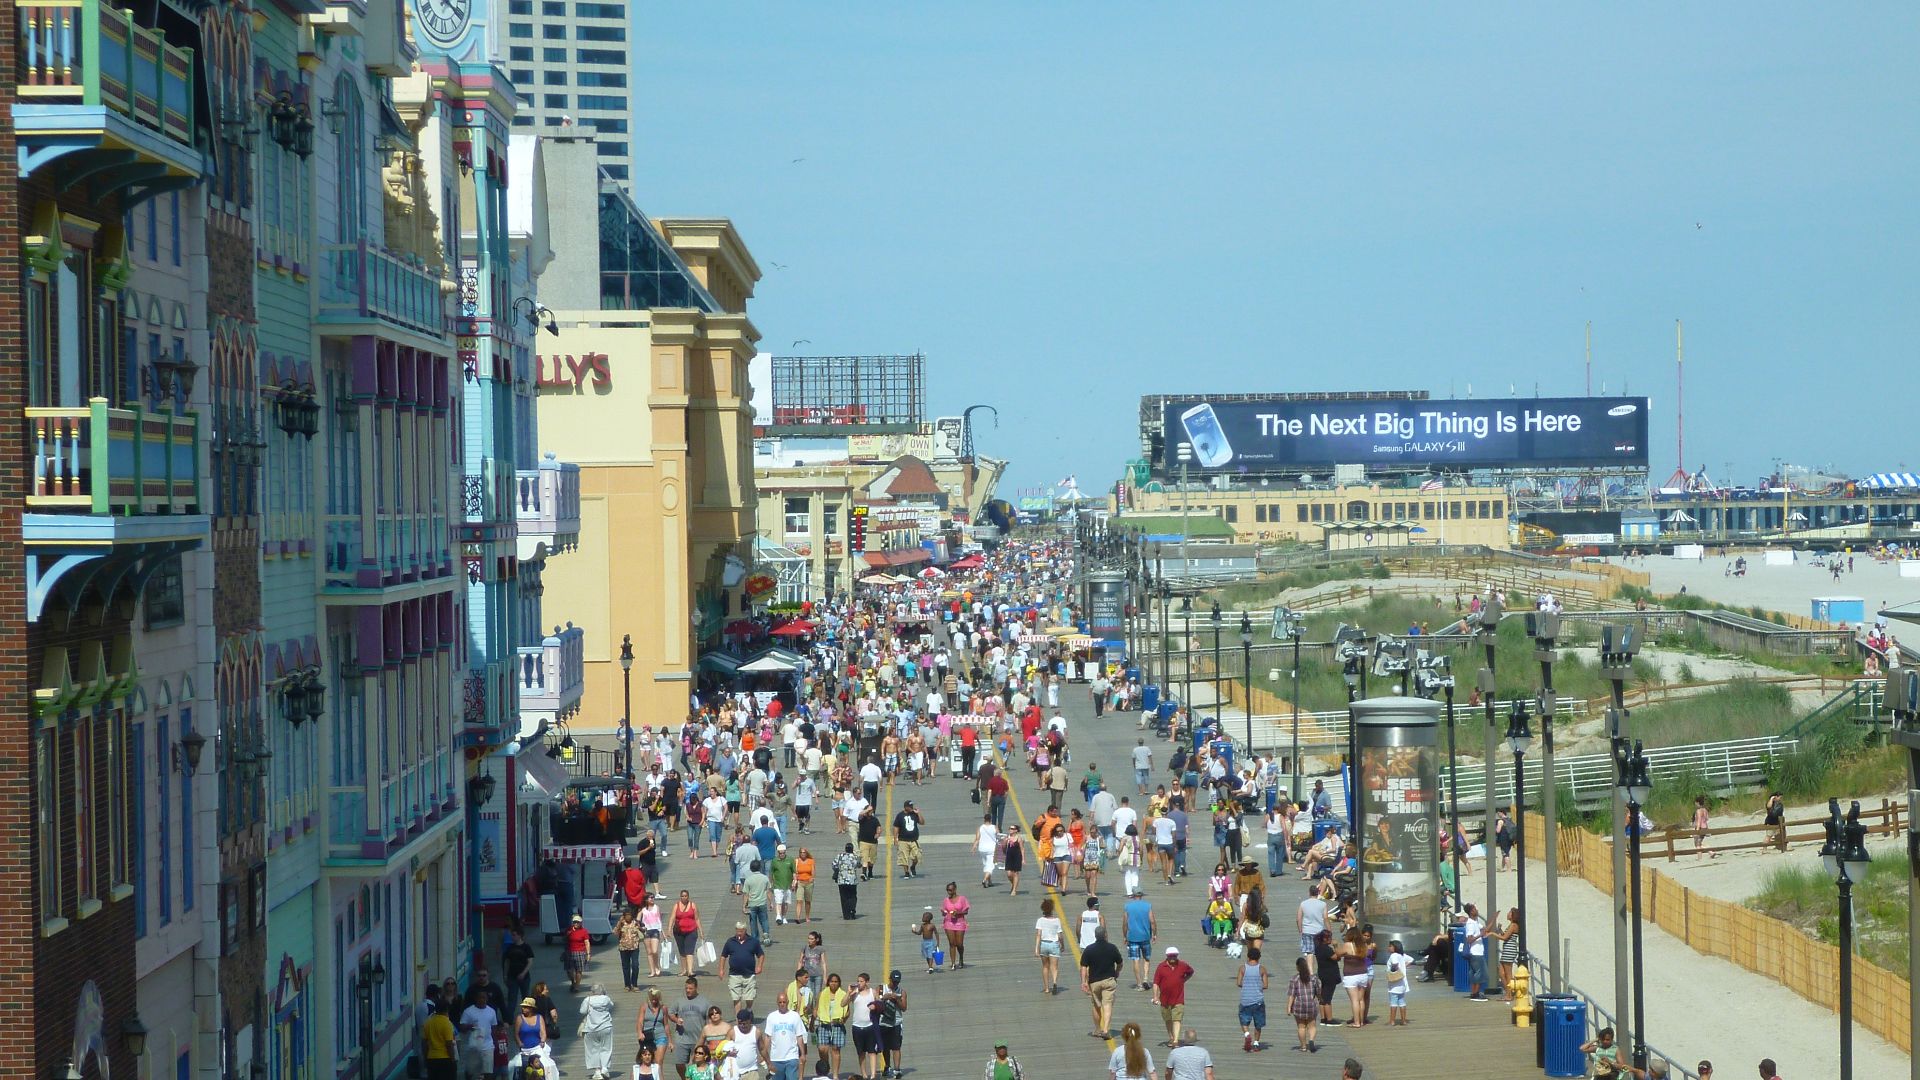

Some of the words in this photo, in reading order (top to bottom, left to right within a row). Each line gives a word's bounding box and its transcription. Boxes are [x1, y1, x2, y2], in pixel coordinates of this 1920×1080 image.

[1256, 414, 1303, 436] The
[1311, 414, 1367, 435] Next
[1375, 413, 1415, 439] Big
[1420, 412, 1489, 439] Thing
[1497, 411, 1517, 433] Is
[1525, 410, 1582, 431] Here
[1373, 445, 1403, 454] Samsung
[1405, 442, 1445, 452] GALAXY
[1388, 778, 1420, 789] SEE
[1372, 790, 1405, 801] THE
[1404, 823, 1422, 832] Hard
